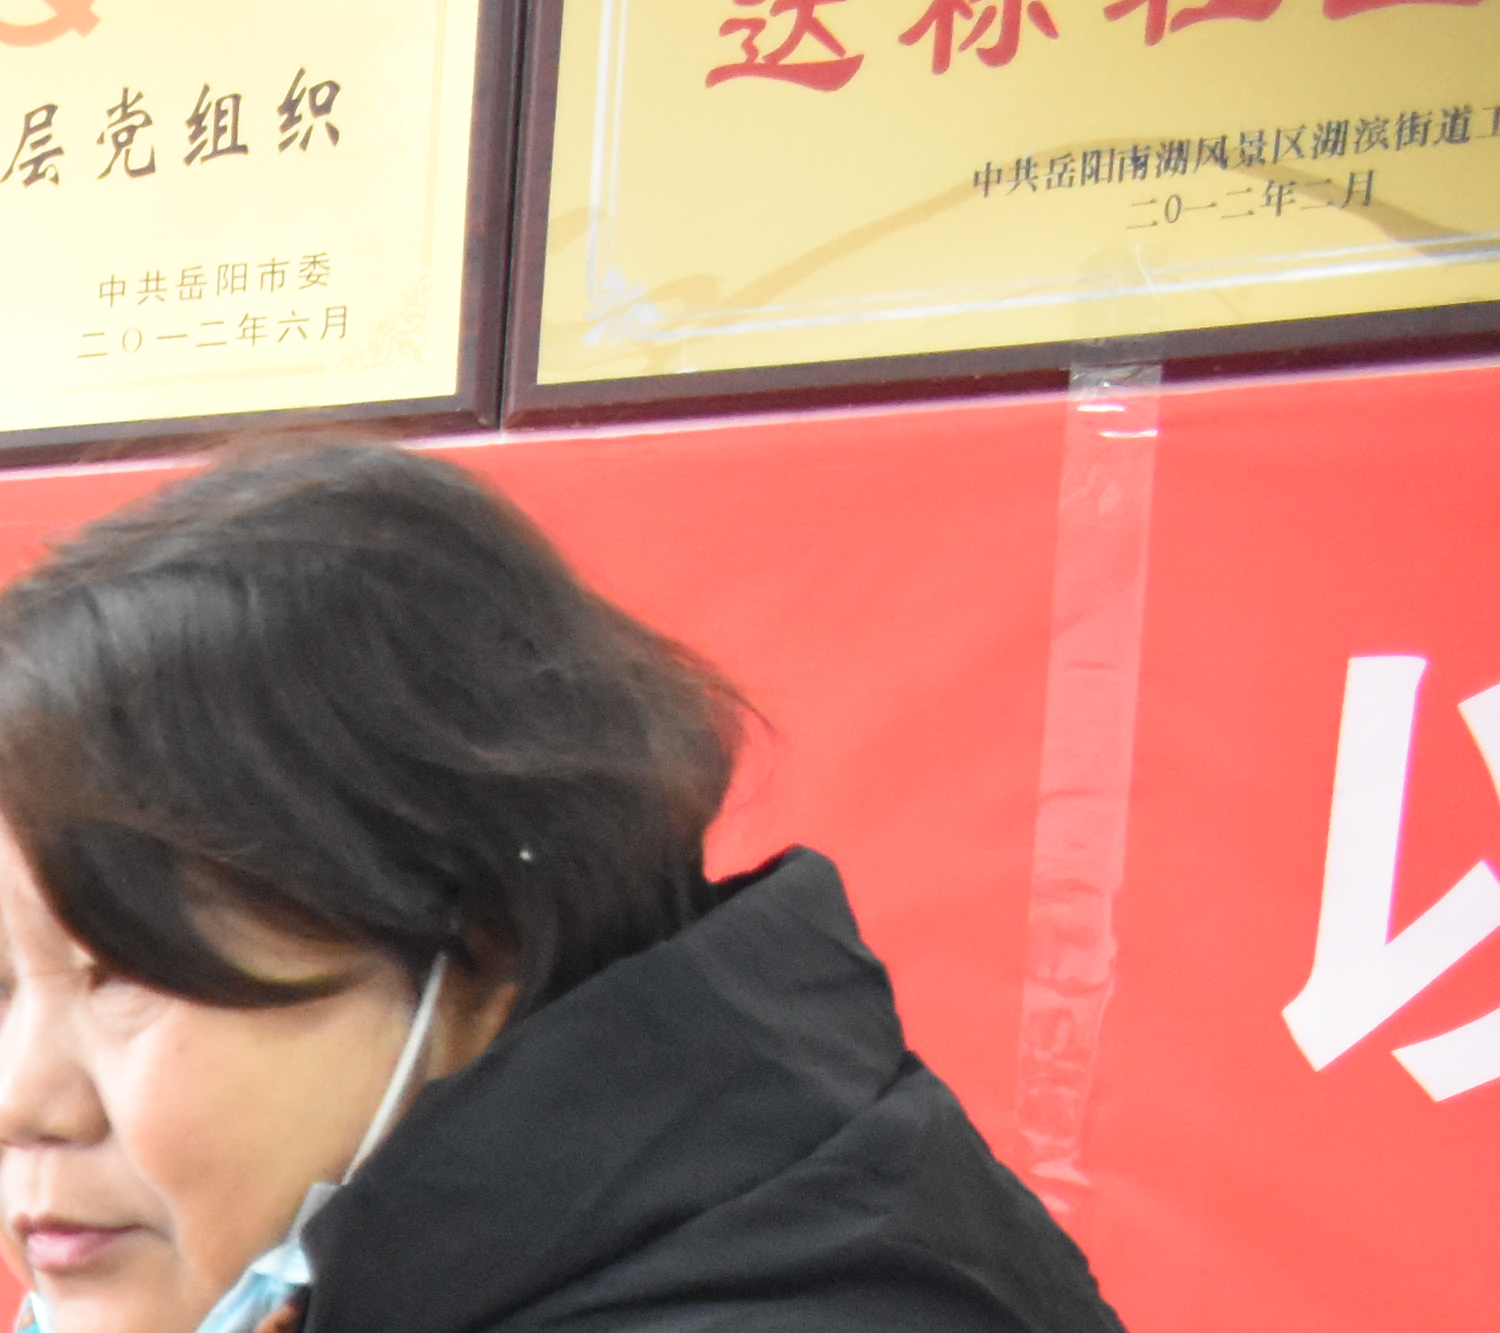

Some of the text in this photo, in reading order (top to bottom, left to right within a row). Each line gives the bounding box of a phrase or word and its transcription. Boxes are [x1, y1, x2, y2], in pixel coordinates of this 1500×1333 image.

[98, 251, 333, 310] 中共岳阳市委
